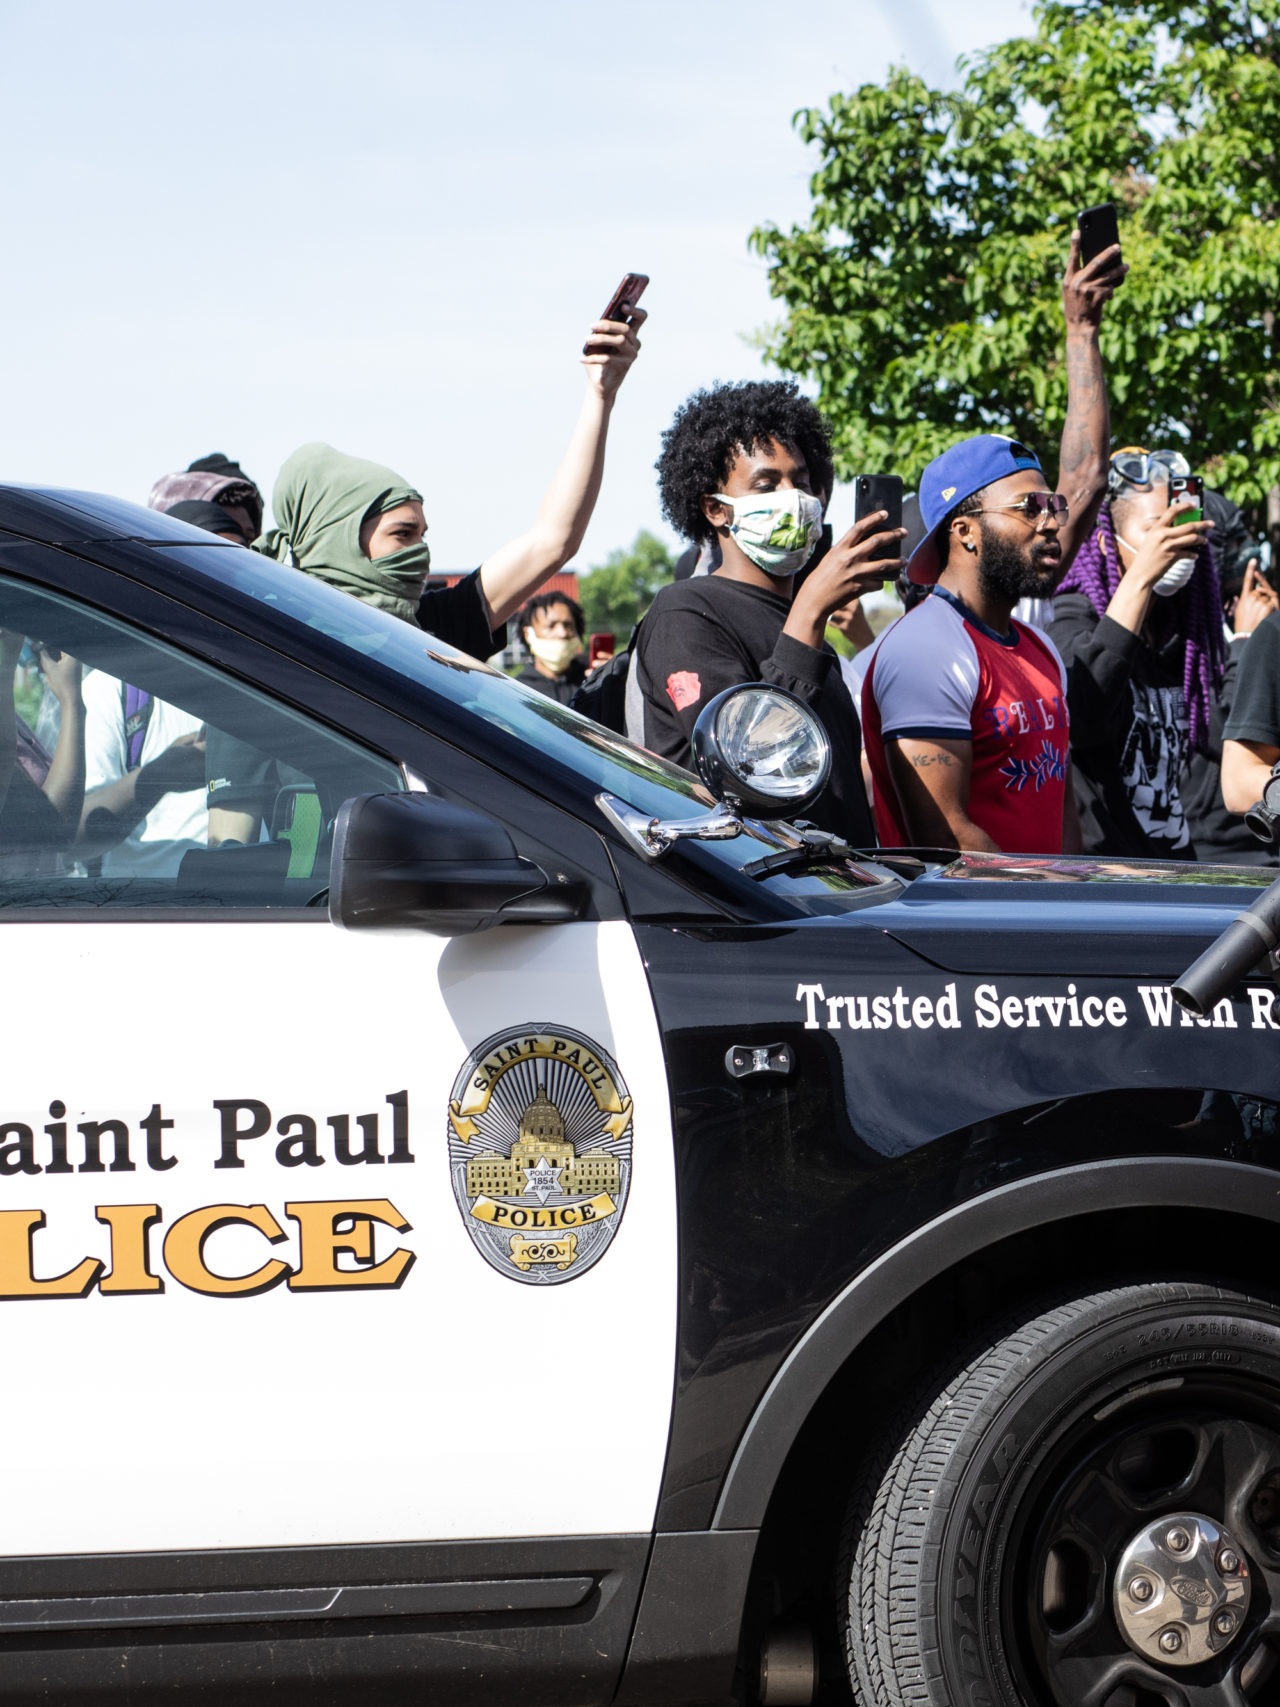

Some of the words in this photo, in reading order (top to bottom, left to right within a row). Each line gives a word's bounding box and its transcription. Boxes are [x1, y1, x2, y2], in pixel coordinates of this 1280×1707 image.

[796, 983, 961, 1030] Trusted
[975, 984, 1127, 1029] Service
[474, 1037, 539, 1092] SAINT
[551, 1039, 607, 1091] PAUL
[214, 1090, 414, 1169] Paul
[533, 1177, 554, 1185] 1854
[491, 1203, 596, 1228] POLICE
